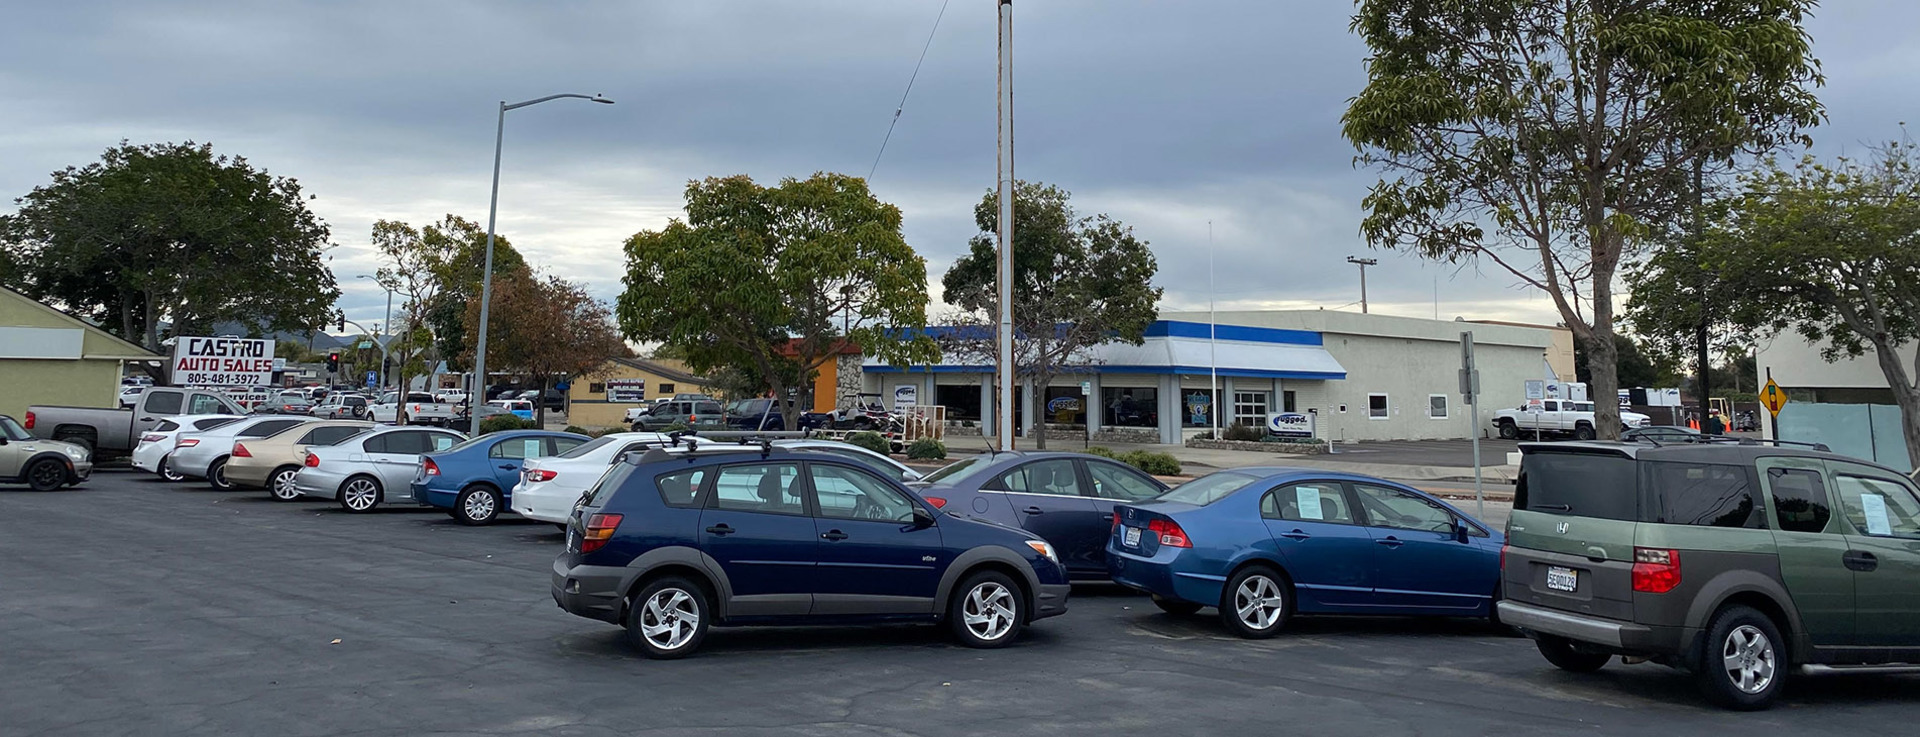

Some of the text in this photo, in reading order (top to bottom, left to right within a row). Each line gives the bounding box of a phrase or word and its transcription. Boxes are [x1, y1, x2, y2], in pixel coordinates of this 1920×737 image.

[189, 339, 265, 357] CASTRO
[177, 358, 273, 372] AUTO SALES
[187, 373, 260, 384] 805-481-3972
[368, 372, 375, 380] H
